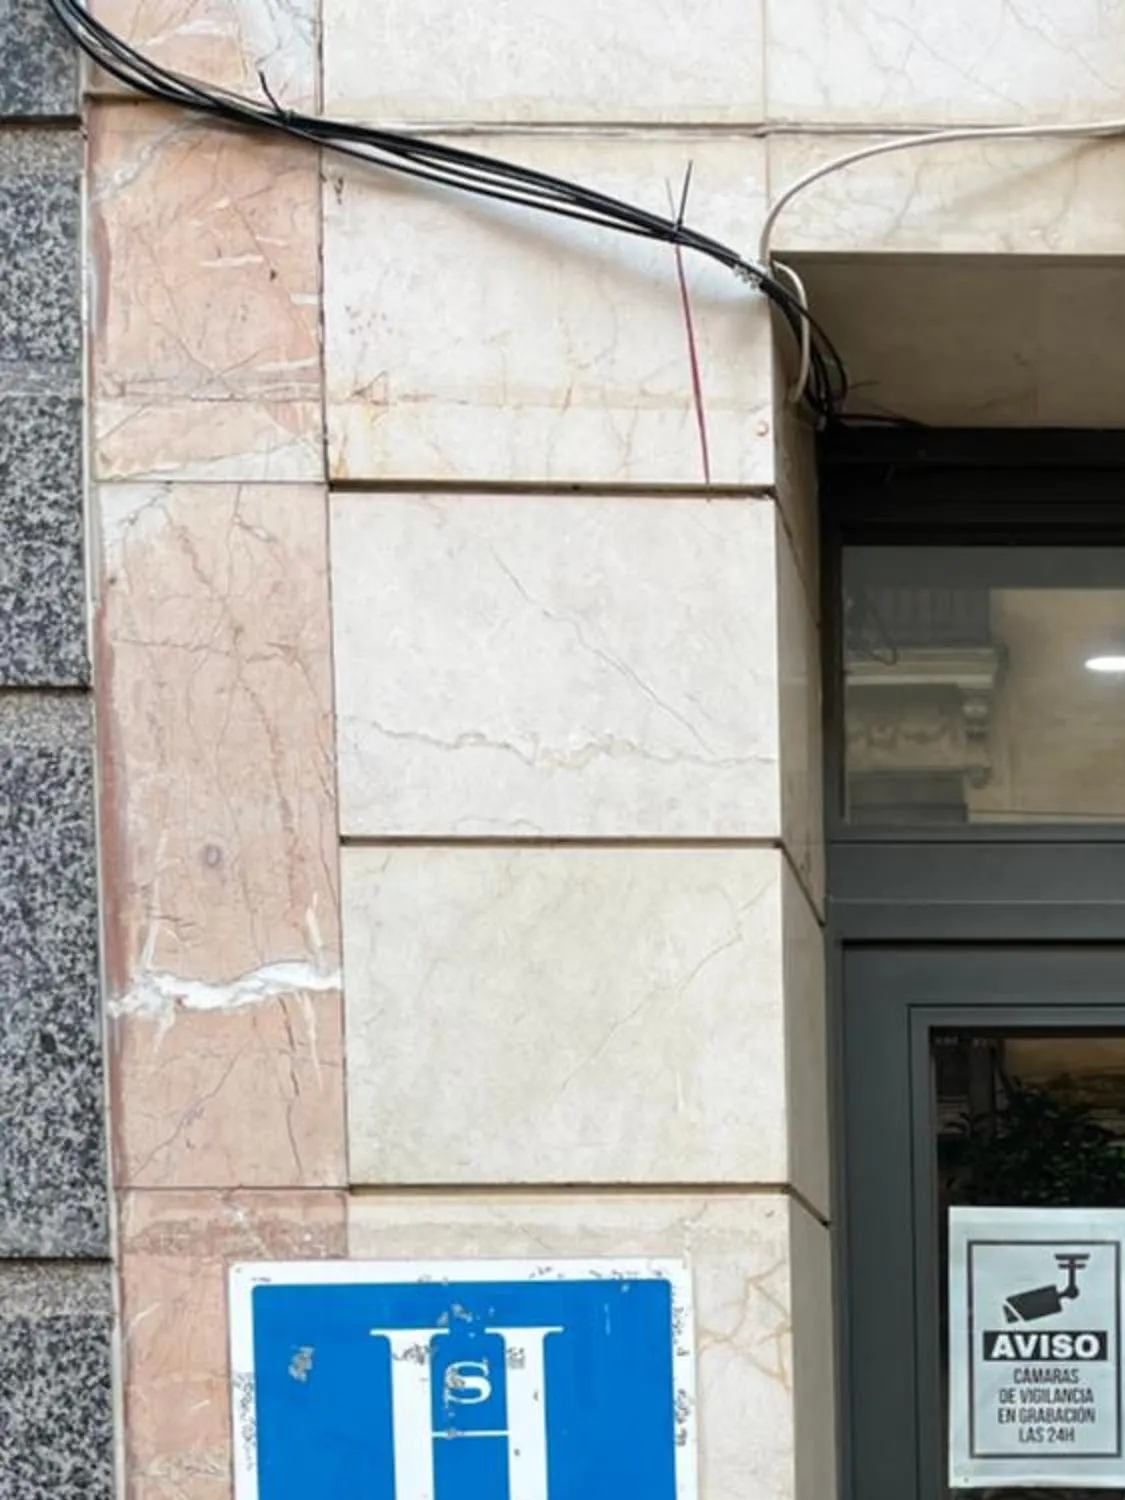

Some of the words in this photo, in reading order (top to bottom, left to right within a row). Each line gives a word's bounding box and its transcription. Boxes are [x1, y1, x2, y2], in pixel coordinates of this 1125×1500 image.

[991, 1334, 1100, 1358] AVISO
[999, 1388, 1016, 1404] DE
[1020, 1388, 1094, 1404] VIGILANCIA
[998, 1407, 1016, 1424] EN
[1018, 1427, 1044, 1443] LAS
[1047, 1426, 1075, 1443] 24H
